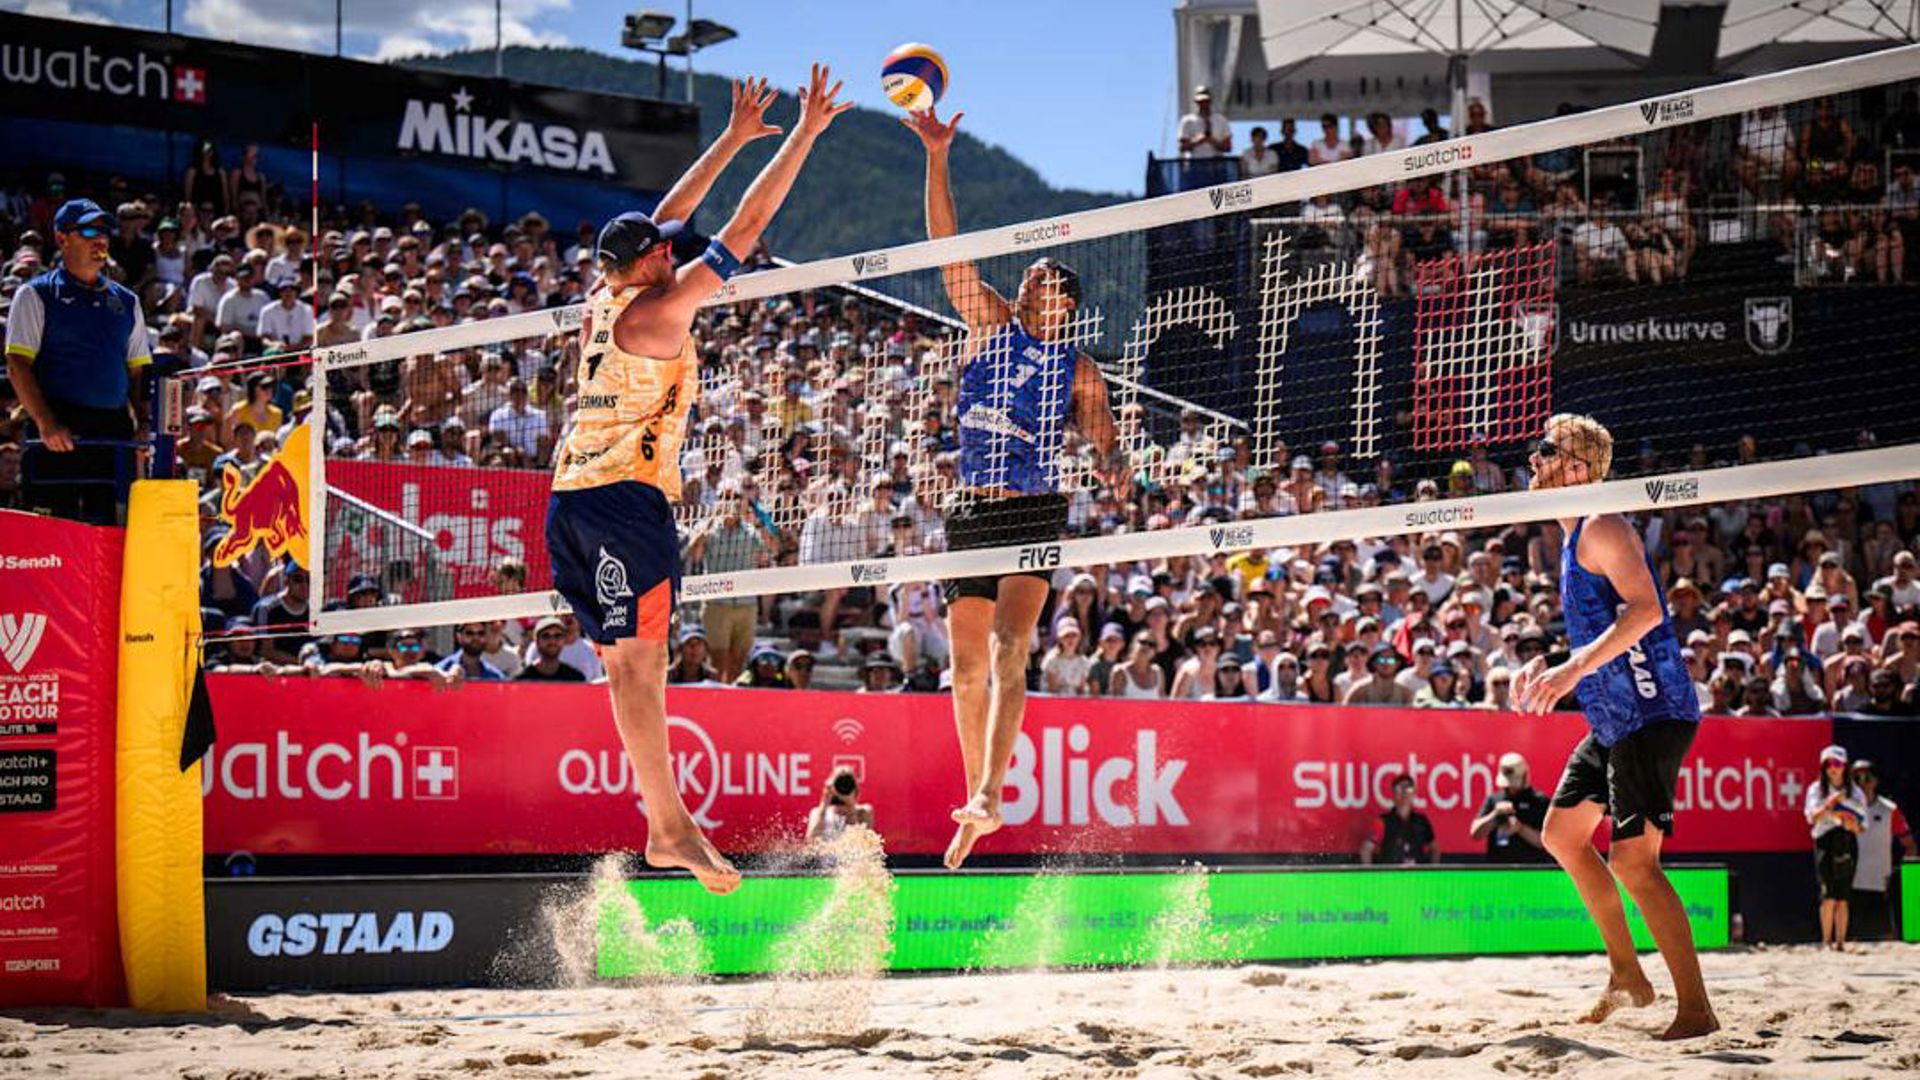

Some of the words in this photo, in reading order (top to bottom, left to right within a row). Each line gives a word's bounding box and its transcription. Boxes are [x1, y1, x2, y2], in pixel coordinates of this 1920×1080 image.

[2, 44, 168, 98] watch
[399, 88, 616, 174] MIKASA
[1404, 147, 1460, 171] swatch
[1014, 223, 1060, 244] swatch
[1570, 318, 1726, 343] Urnerkurve
[587, 352, 604, 381] 1
[1406, 506, 1462, 526] swatch
[5, 554, 61, 570] Senoh
[0, 682, 59, 706] EACH
[13, 703, 58, 720] TOUR
[202, 730, 404, 800] atch
[558, 749, 811, 796] QUKLINE
[999, 723, 1191, 828] Blick
[22, 774, 49, 787] PRO
[1293, 752, 1494, 809] swatch
[1672, 757, 1773, 811] atch
[0, 793, 42, 805] STAAD
[0, 893, 45, 911] atch
[247, 911, 454, 957] GSTAAD
